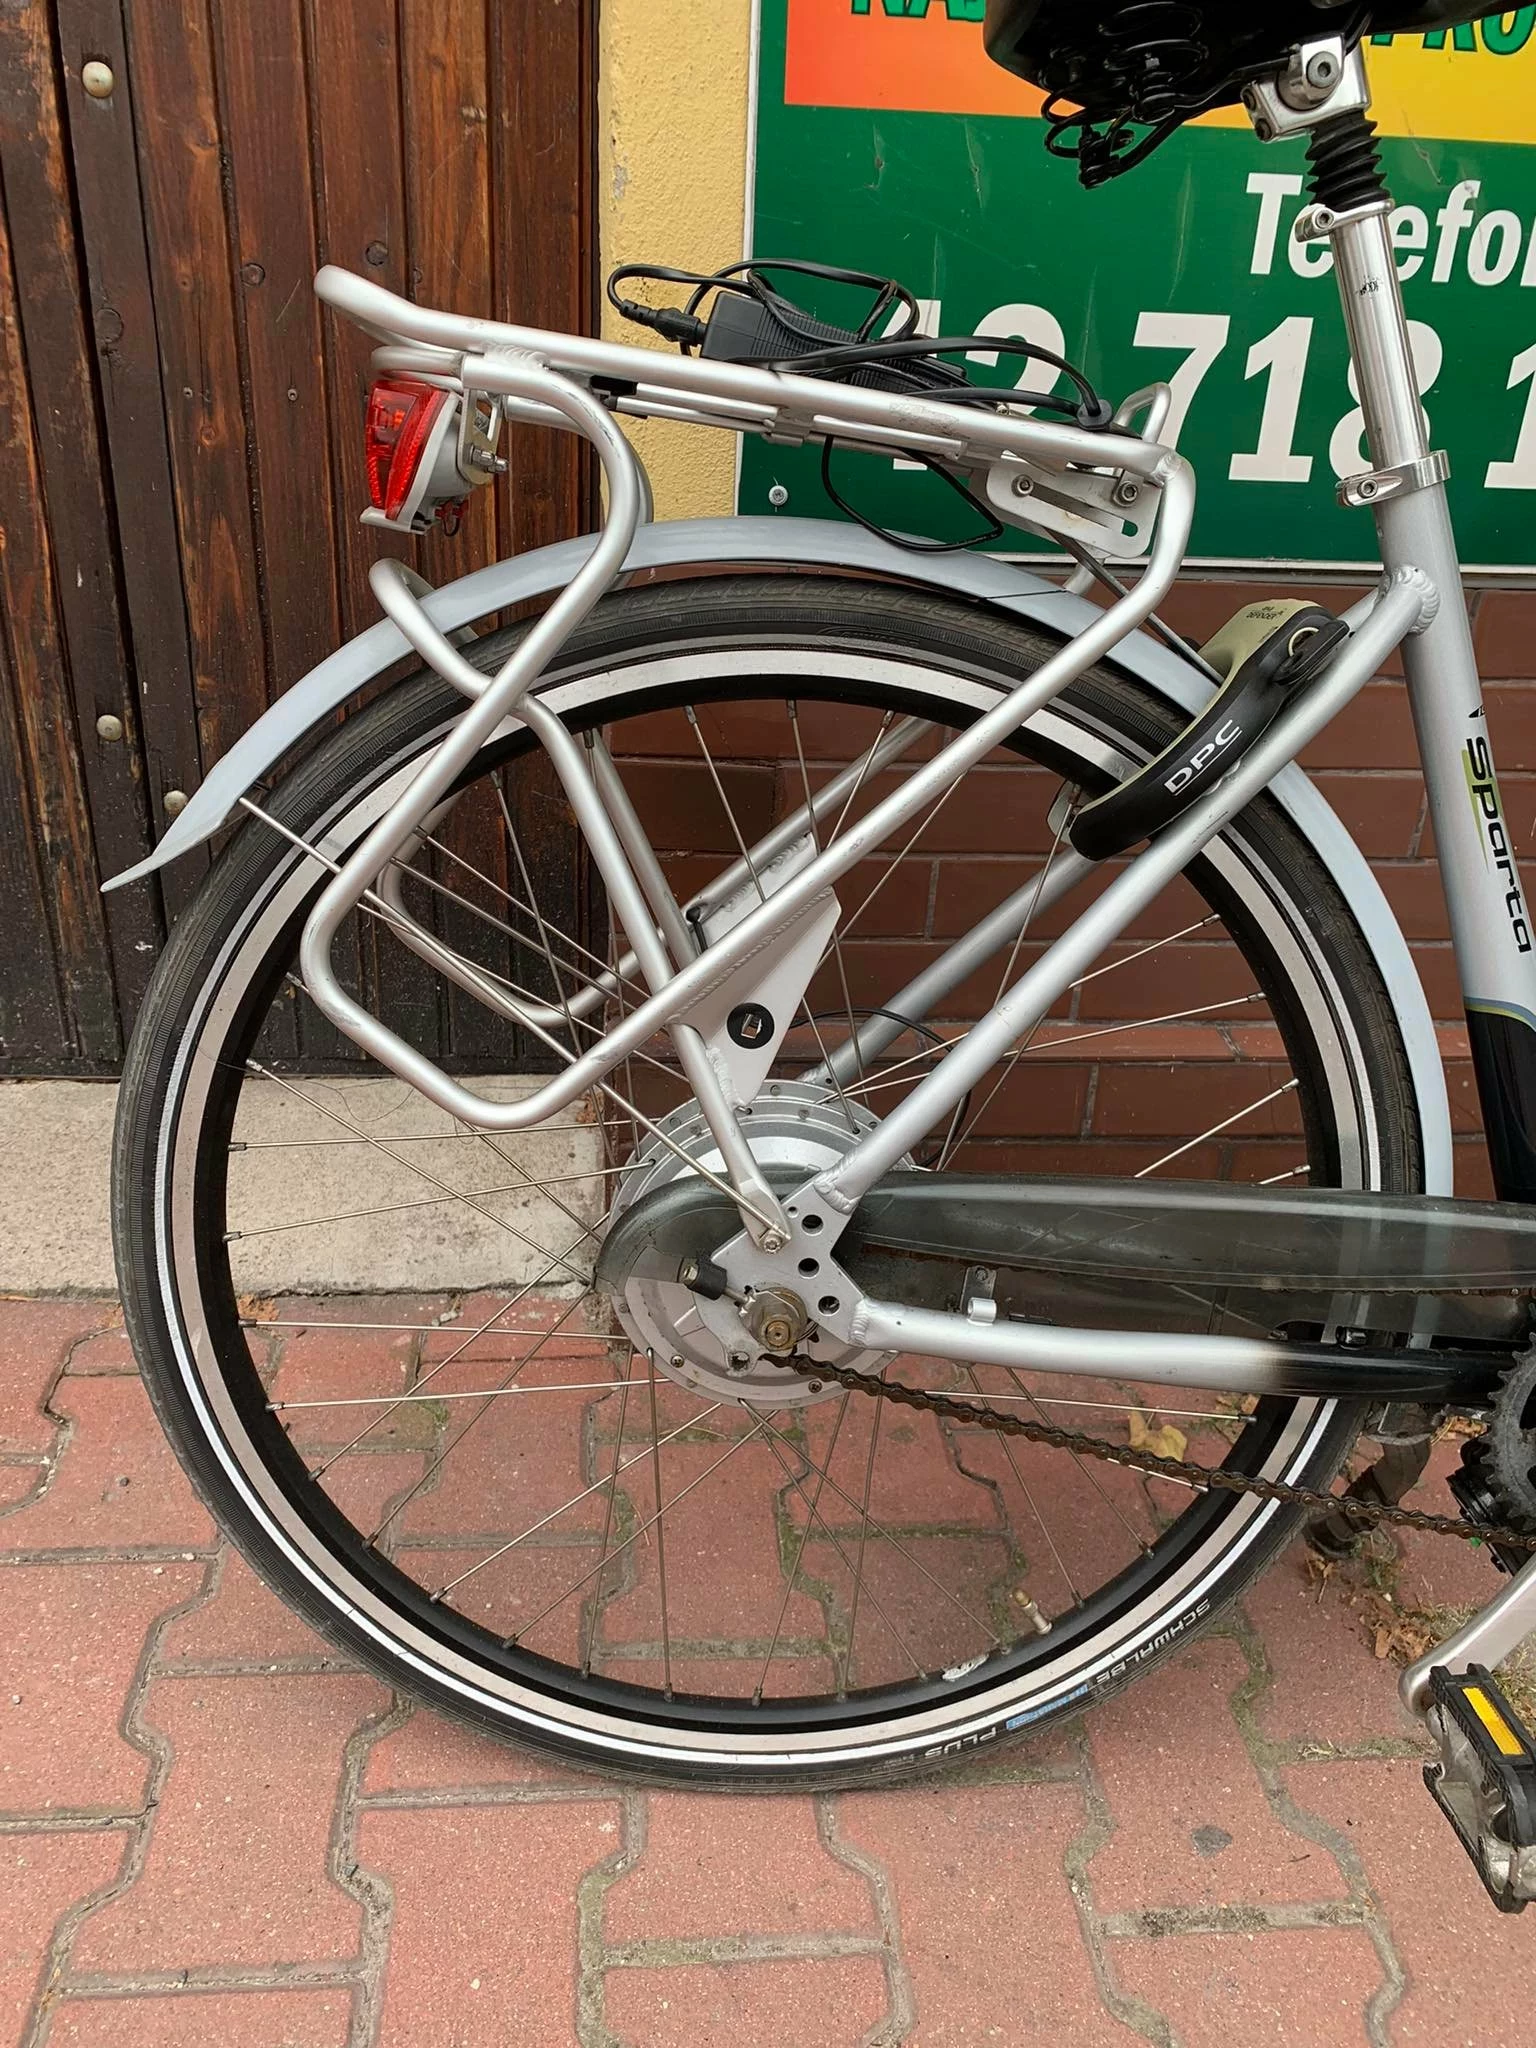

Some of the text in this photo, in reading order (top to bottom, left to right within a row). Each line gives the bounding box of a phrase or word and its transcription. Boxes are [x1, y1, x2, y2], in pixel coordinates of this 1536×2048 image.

[1164, 719, 1240, 794] DPC
[1095, 1599, 1210, 1684] SCHWALBE
[924, 1726, 997, 1759] PLUS
